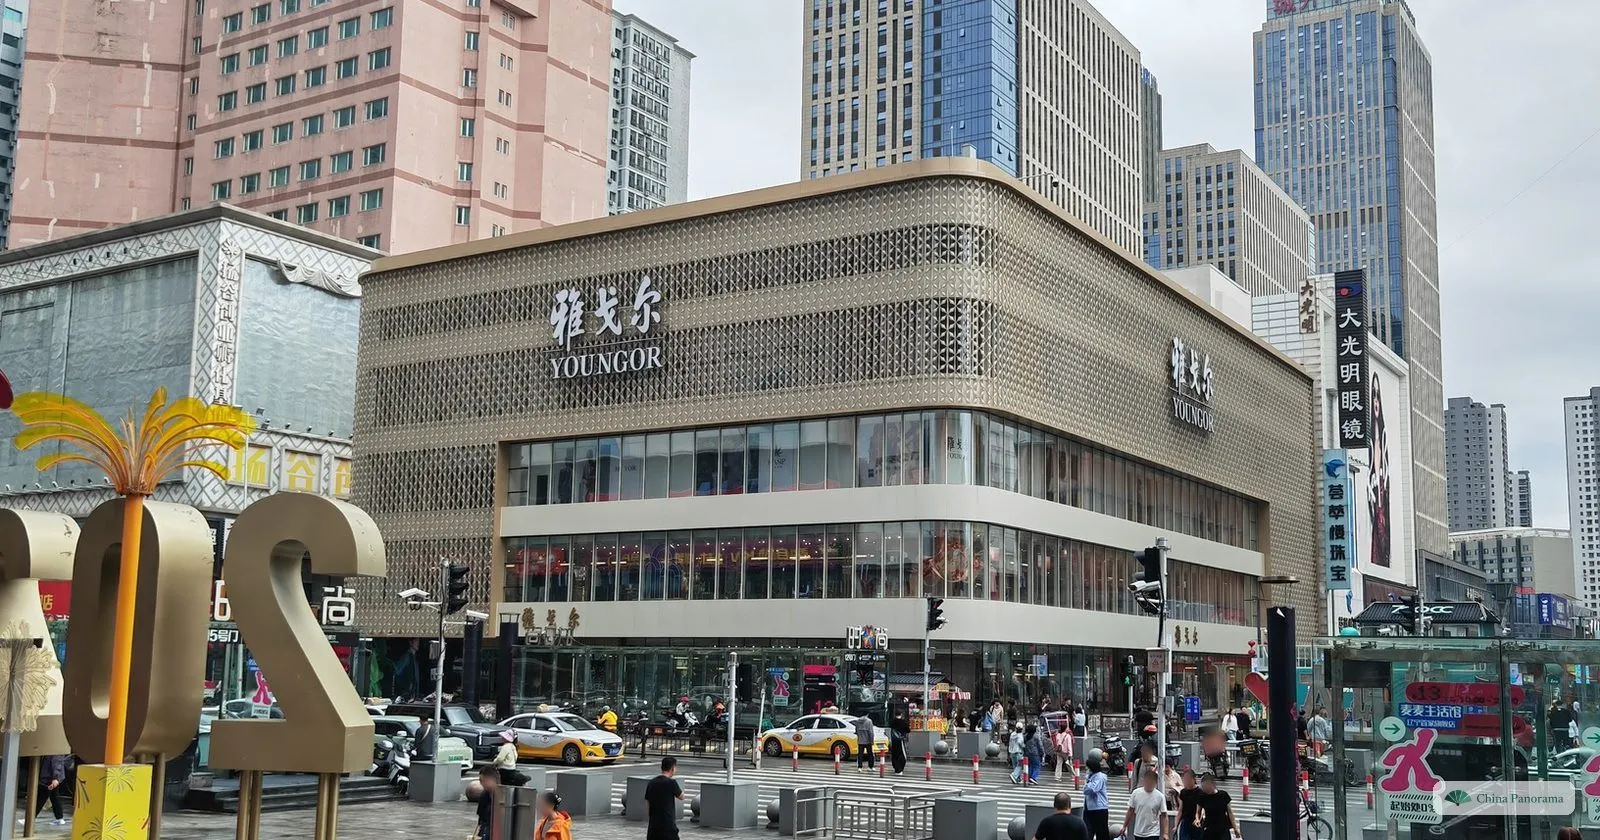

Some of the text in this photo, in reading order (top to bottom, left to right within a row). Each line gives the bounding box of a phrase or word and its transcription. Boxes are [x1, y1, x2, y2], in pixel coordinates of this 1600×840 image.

[550, 275, 661, 352] 雅戈尔
[1300, 280, 1315, 334] 大光明
[550, 346, 662, 379] YOUNGOR
[1171, 336, 1214, 402] 雅戈尔
[1339, 308, 1365, 440] 大光明眼镜
[1173, 396, 1215, 433] YOUNGOR
[1328, 484, 1347, 582] 荟萃楼珠宝
